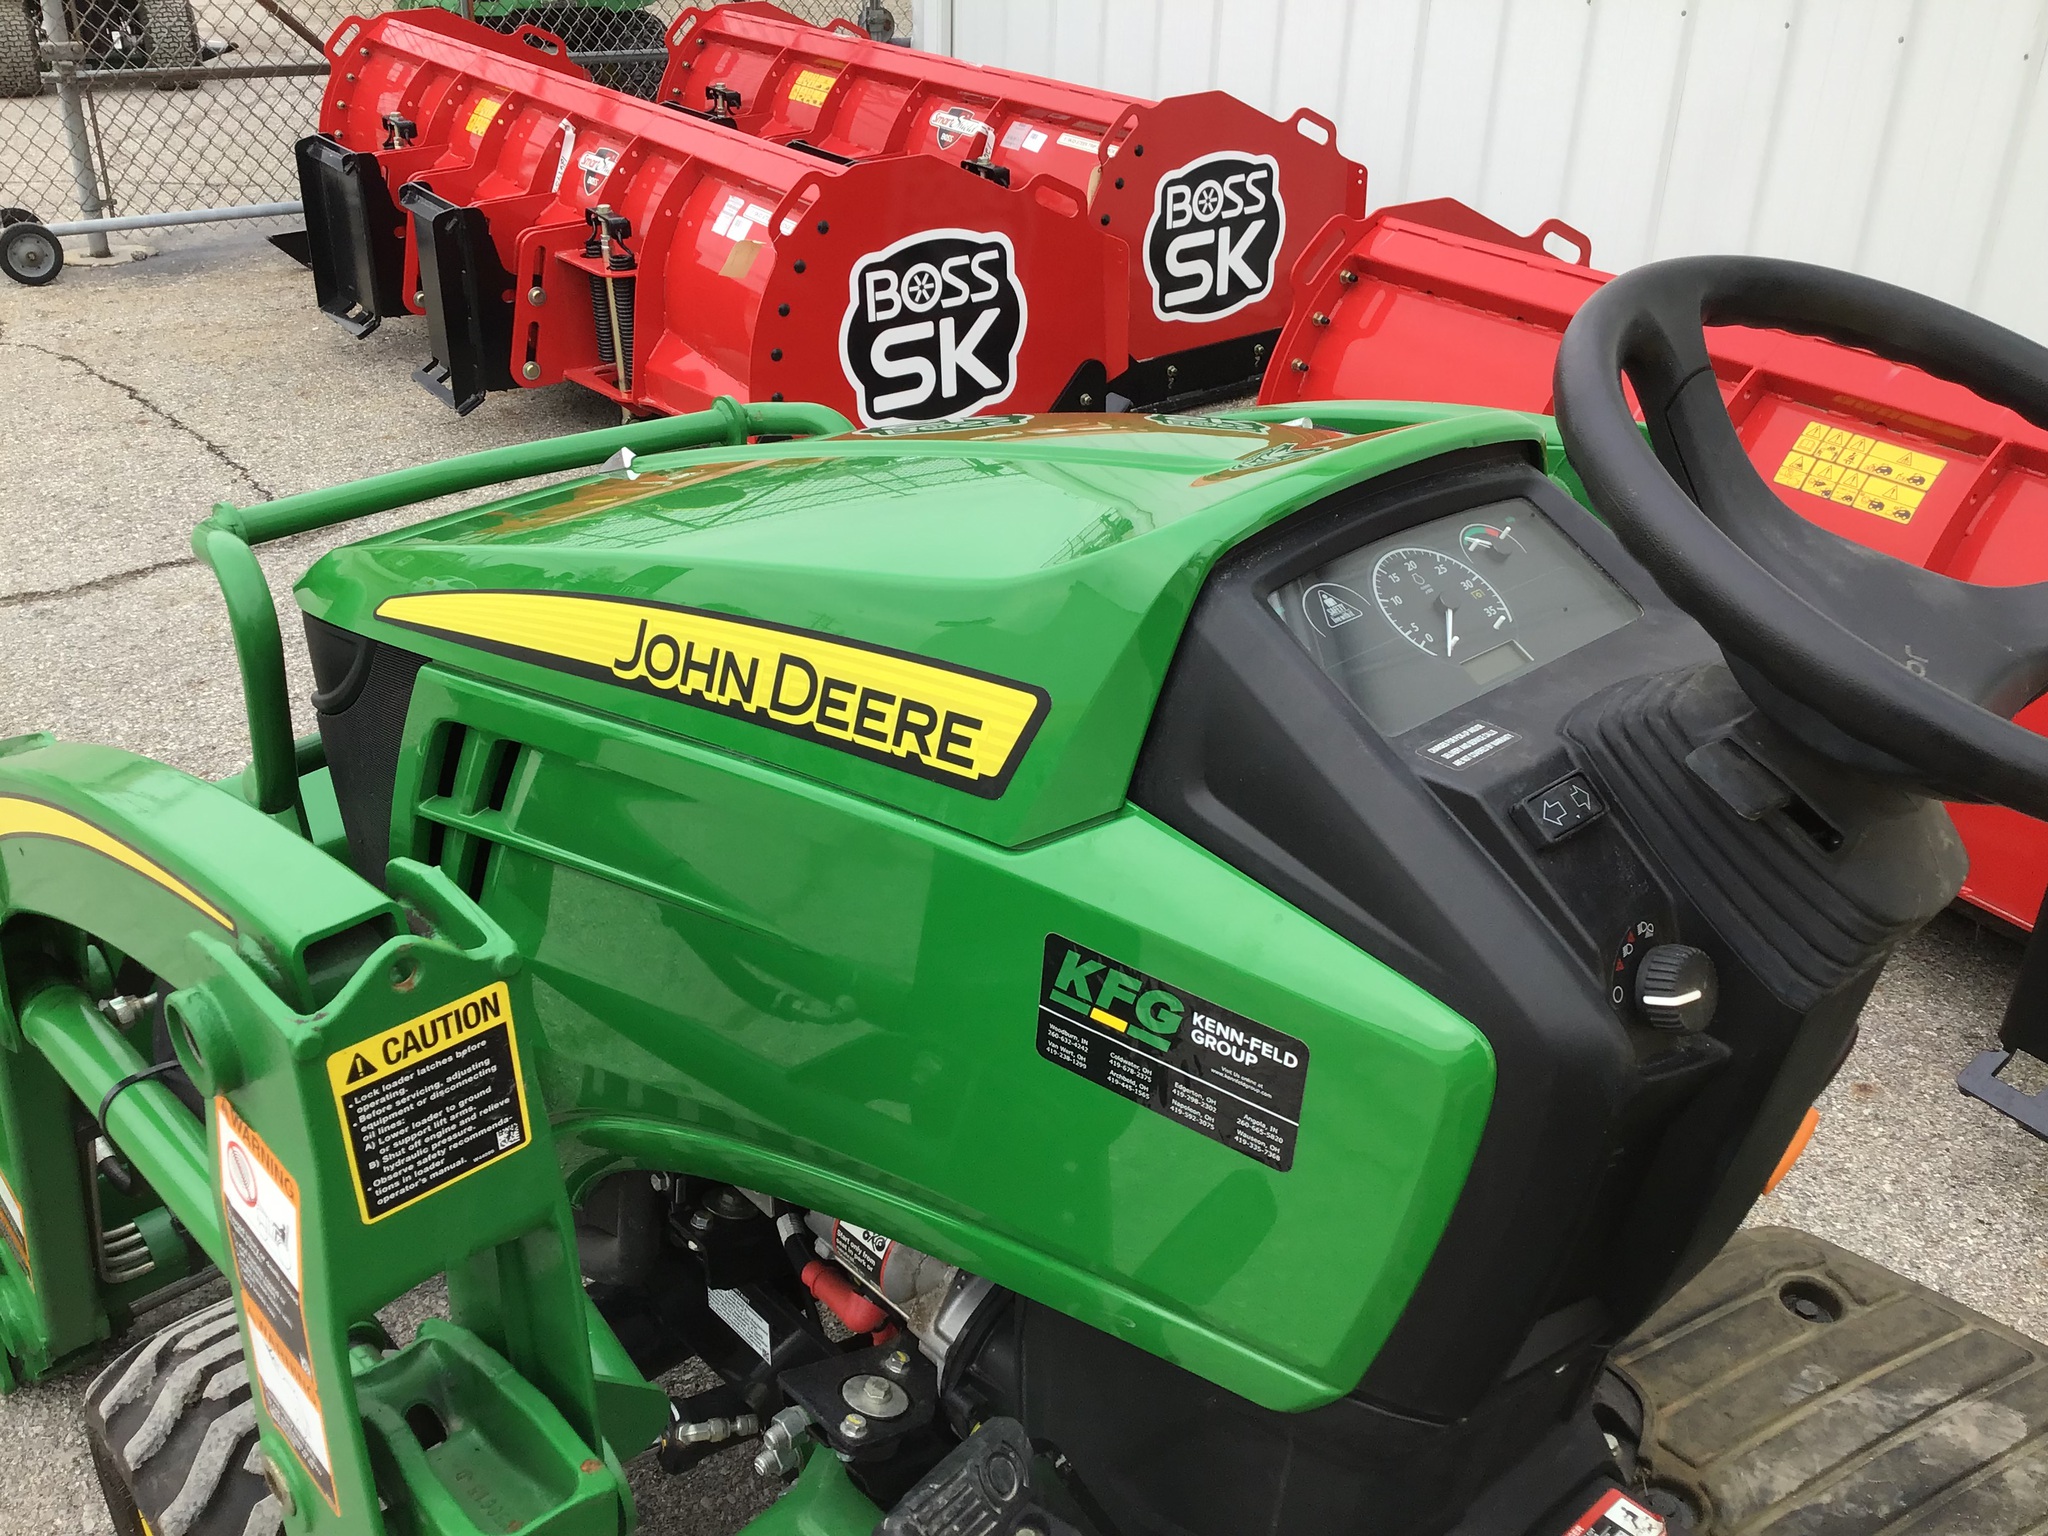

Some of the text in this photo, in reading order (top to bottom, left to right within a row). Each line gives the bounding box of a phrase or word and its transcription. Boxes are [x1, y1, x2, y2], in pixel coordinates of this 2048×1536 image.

[1166, 169, 1268, 230] BOSS
[1164, 219, 1266, 308] SK
[865, 249, 1000, 323] BOSS
[870, 307, 1002, 413] SK
[1388, 572, 1400, 584] 15
[1404, 560, 1418, 572] 20
[1434, 564, 1448, 576] 25
[1460, 579, 1474, 591] 30
[1390, 595, 1403, 606] 10
[1483, 605, 1497, 617] 35
[1411, 622, 1419, 632] 5
[1425, 633, 1434, 643] 0
[613, 619, 983, 771] JOHN DEERE
[1054, 949, 1185, 1035] KFG
[381, 991, 501, 1066] CAUTION
[1047, 1029, 1089, 1053] 260-632-4242
[1048, 1023, 1089, 1046] Woodburn, IN
[1192, 1011, 1299, 1069] KENN-FELD
[1046, 1046, 1087, 1070] 419-238-1299
[1047, 1040, 1087, 1062] Van Wert, OH
[1190, 1029, 1259, 1068] GROUP
[354, 1040, 487, 1105] Lock loader latches before
[1108, 1059, 1152, 1083] 419-678-2375
[1109, 1052, 1153, 1076] Coldwater, OH
[358, 1057, 491, 1124] Before servicing, adjusting
[1107, 1075, 1150, 1100] 419-445-1565
[1109, 1069, 1149, 1092] Archbold, OH
[356, 1087, 409, 1115] operating.
[360, 1064, 497, 1135] equipment or disconnecting
[1172, 1088, 1217, 1114] 419-298-2302
[1174, 1082, 1217, 1106] Edgerton, OH
[364, 1085, 492, 1151] A) Lower loader to ground
[1170, 1106, 1215, 1131] 419-592-3075
[1171, 1099, 1215, 1123] Napoleon, OH
[1243, 1114, 1279, 1134] Angola, IN
[362, 1118, 406, 1142] oil lines:
[368, 1097, 511, 1170] B) Shut off engine and relieve
[379, 1106, 477, 1154] or support lift arms.
[1236, 1118, 1284, 1144] 260-665-5820
[231, 1115, 295, 1199] WARNING
[373, 1116, 513, 1187] Observe safety recommenda-
[382, 1126, 476, 1173] hydraulic pressure.
[1269, 1144, 1281, 1154] OH
[374, 1158, 445, 1196] tions in loader
[377, 1177, 427, 1205] operator's
[429, 1156, 467, 1179] manual.
[837, 1229, 876, 1266] Start only from
[848, 1247, 854, 1256] in
[854, 1253, 867, 1267] park
[866, 1264, 874, 1272] or
